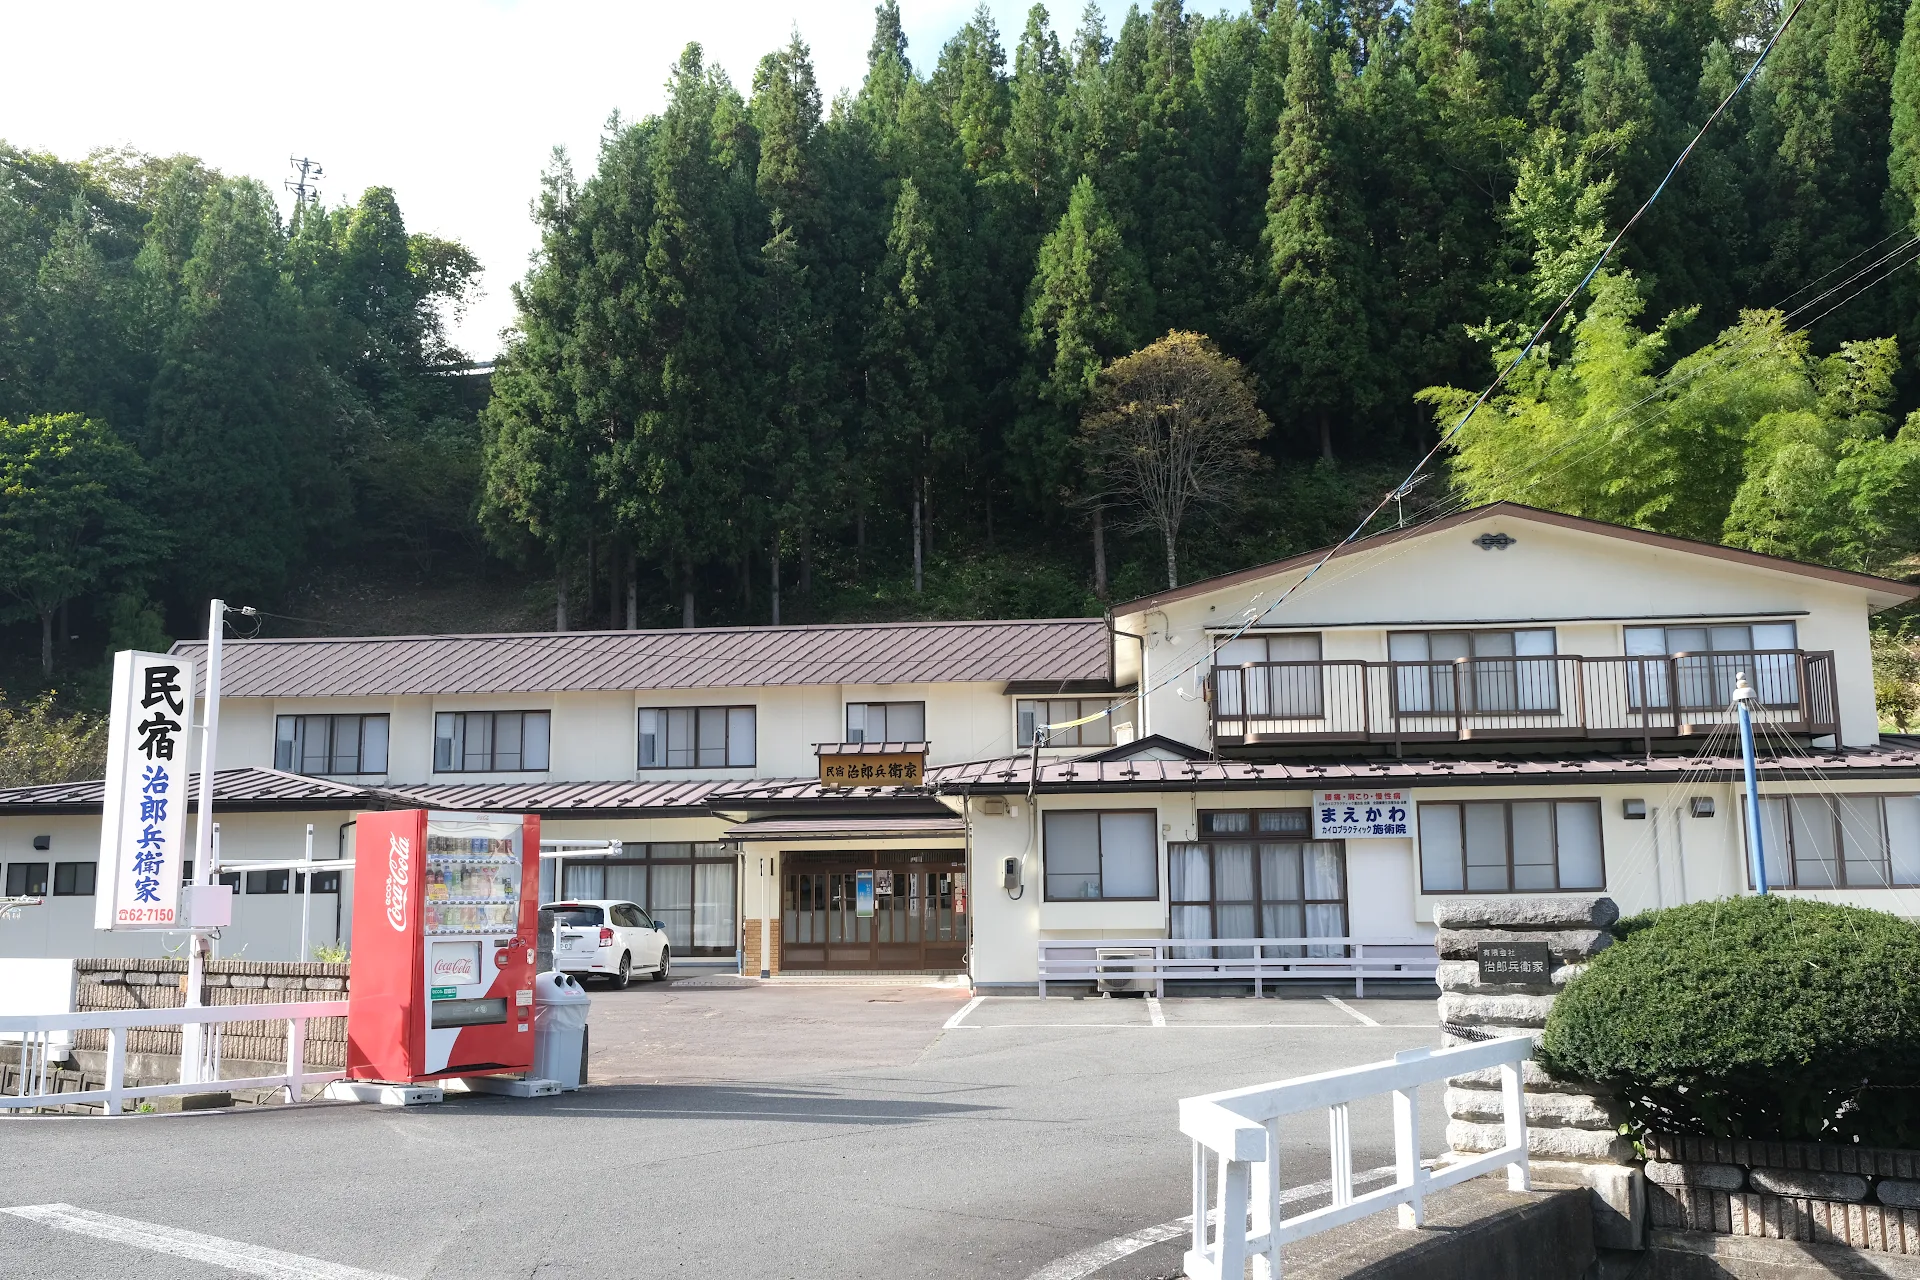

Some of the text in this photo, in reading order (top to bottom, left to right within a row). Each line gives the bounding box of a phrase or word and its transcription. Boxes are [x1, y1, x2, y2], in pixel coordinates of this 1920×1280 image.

[826, 762, 917, 779] 民宿 治郎兵衛家
[132, 665, 184, 903] 民宿 治郎兵衛家
[1321, 806, 1406, 823] まえかわ
[387, 831, 409, 932] Coca-Cola
[129, 908, 174, 921] 62-7150
[1482, 948, 1515, 957] 有限会社
[434, 959, 473, 974] Coca-Cola
[1484, 960, 1544, 973] 治郎兵衛家
